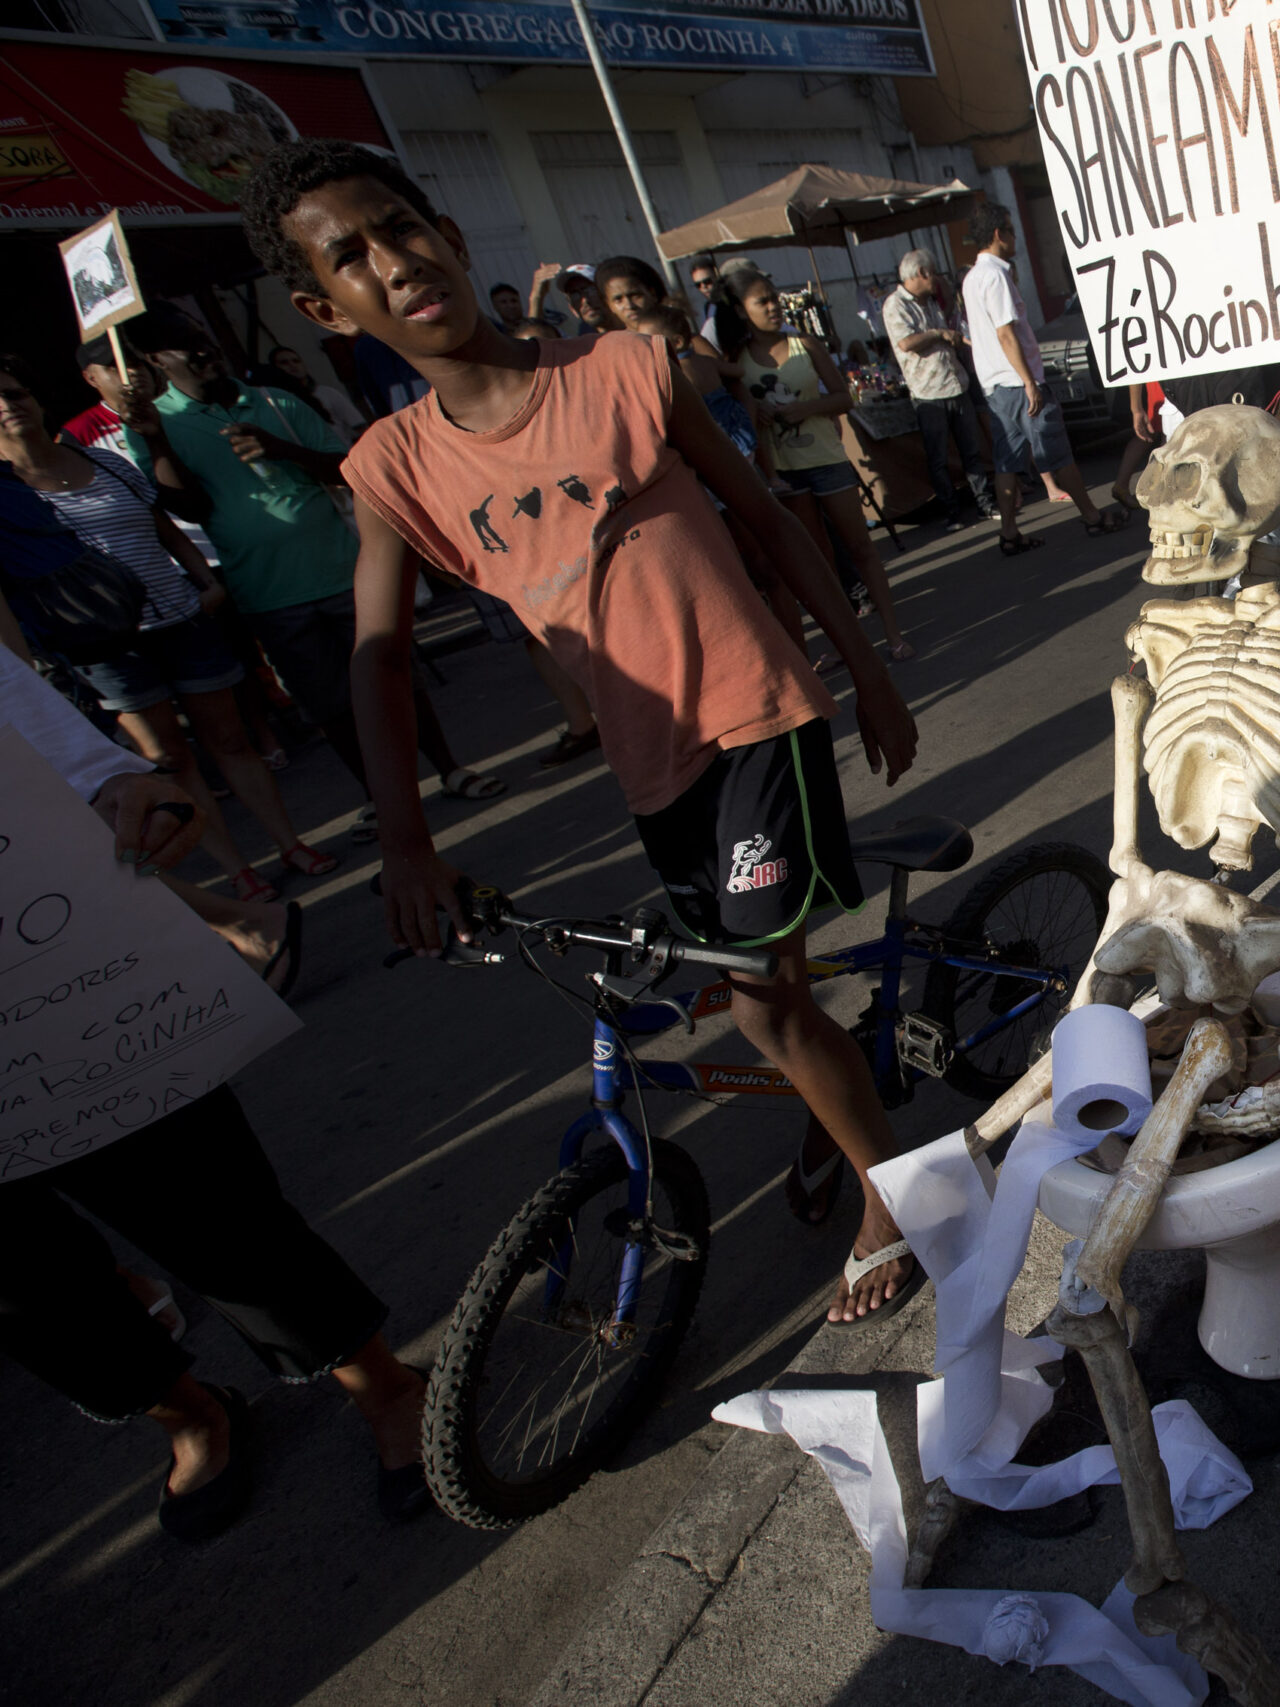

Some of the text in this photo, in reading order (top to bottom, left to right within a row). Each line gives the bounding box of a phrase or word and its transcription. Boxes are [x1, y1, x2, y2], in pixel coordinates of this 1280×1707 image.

[338, 6, 635, 52] CONGREGAÇÃO
[640, 23, 778, 57] ROCINHA
[781, 36, 795, 57] 4
[85, 205, 97, 217] e
[1076, 254, 1151, 383] Zé
[709, 1070, 772, 1087] Peaks
